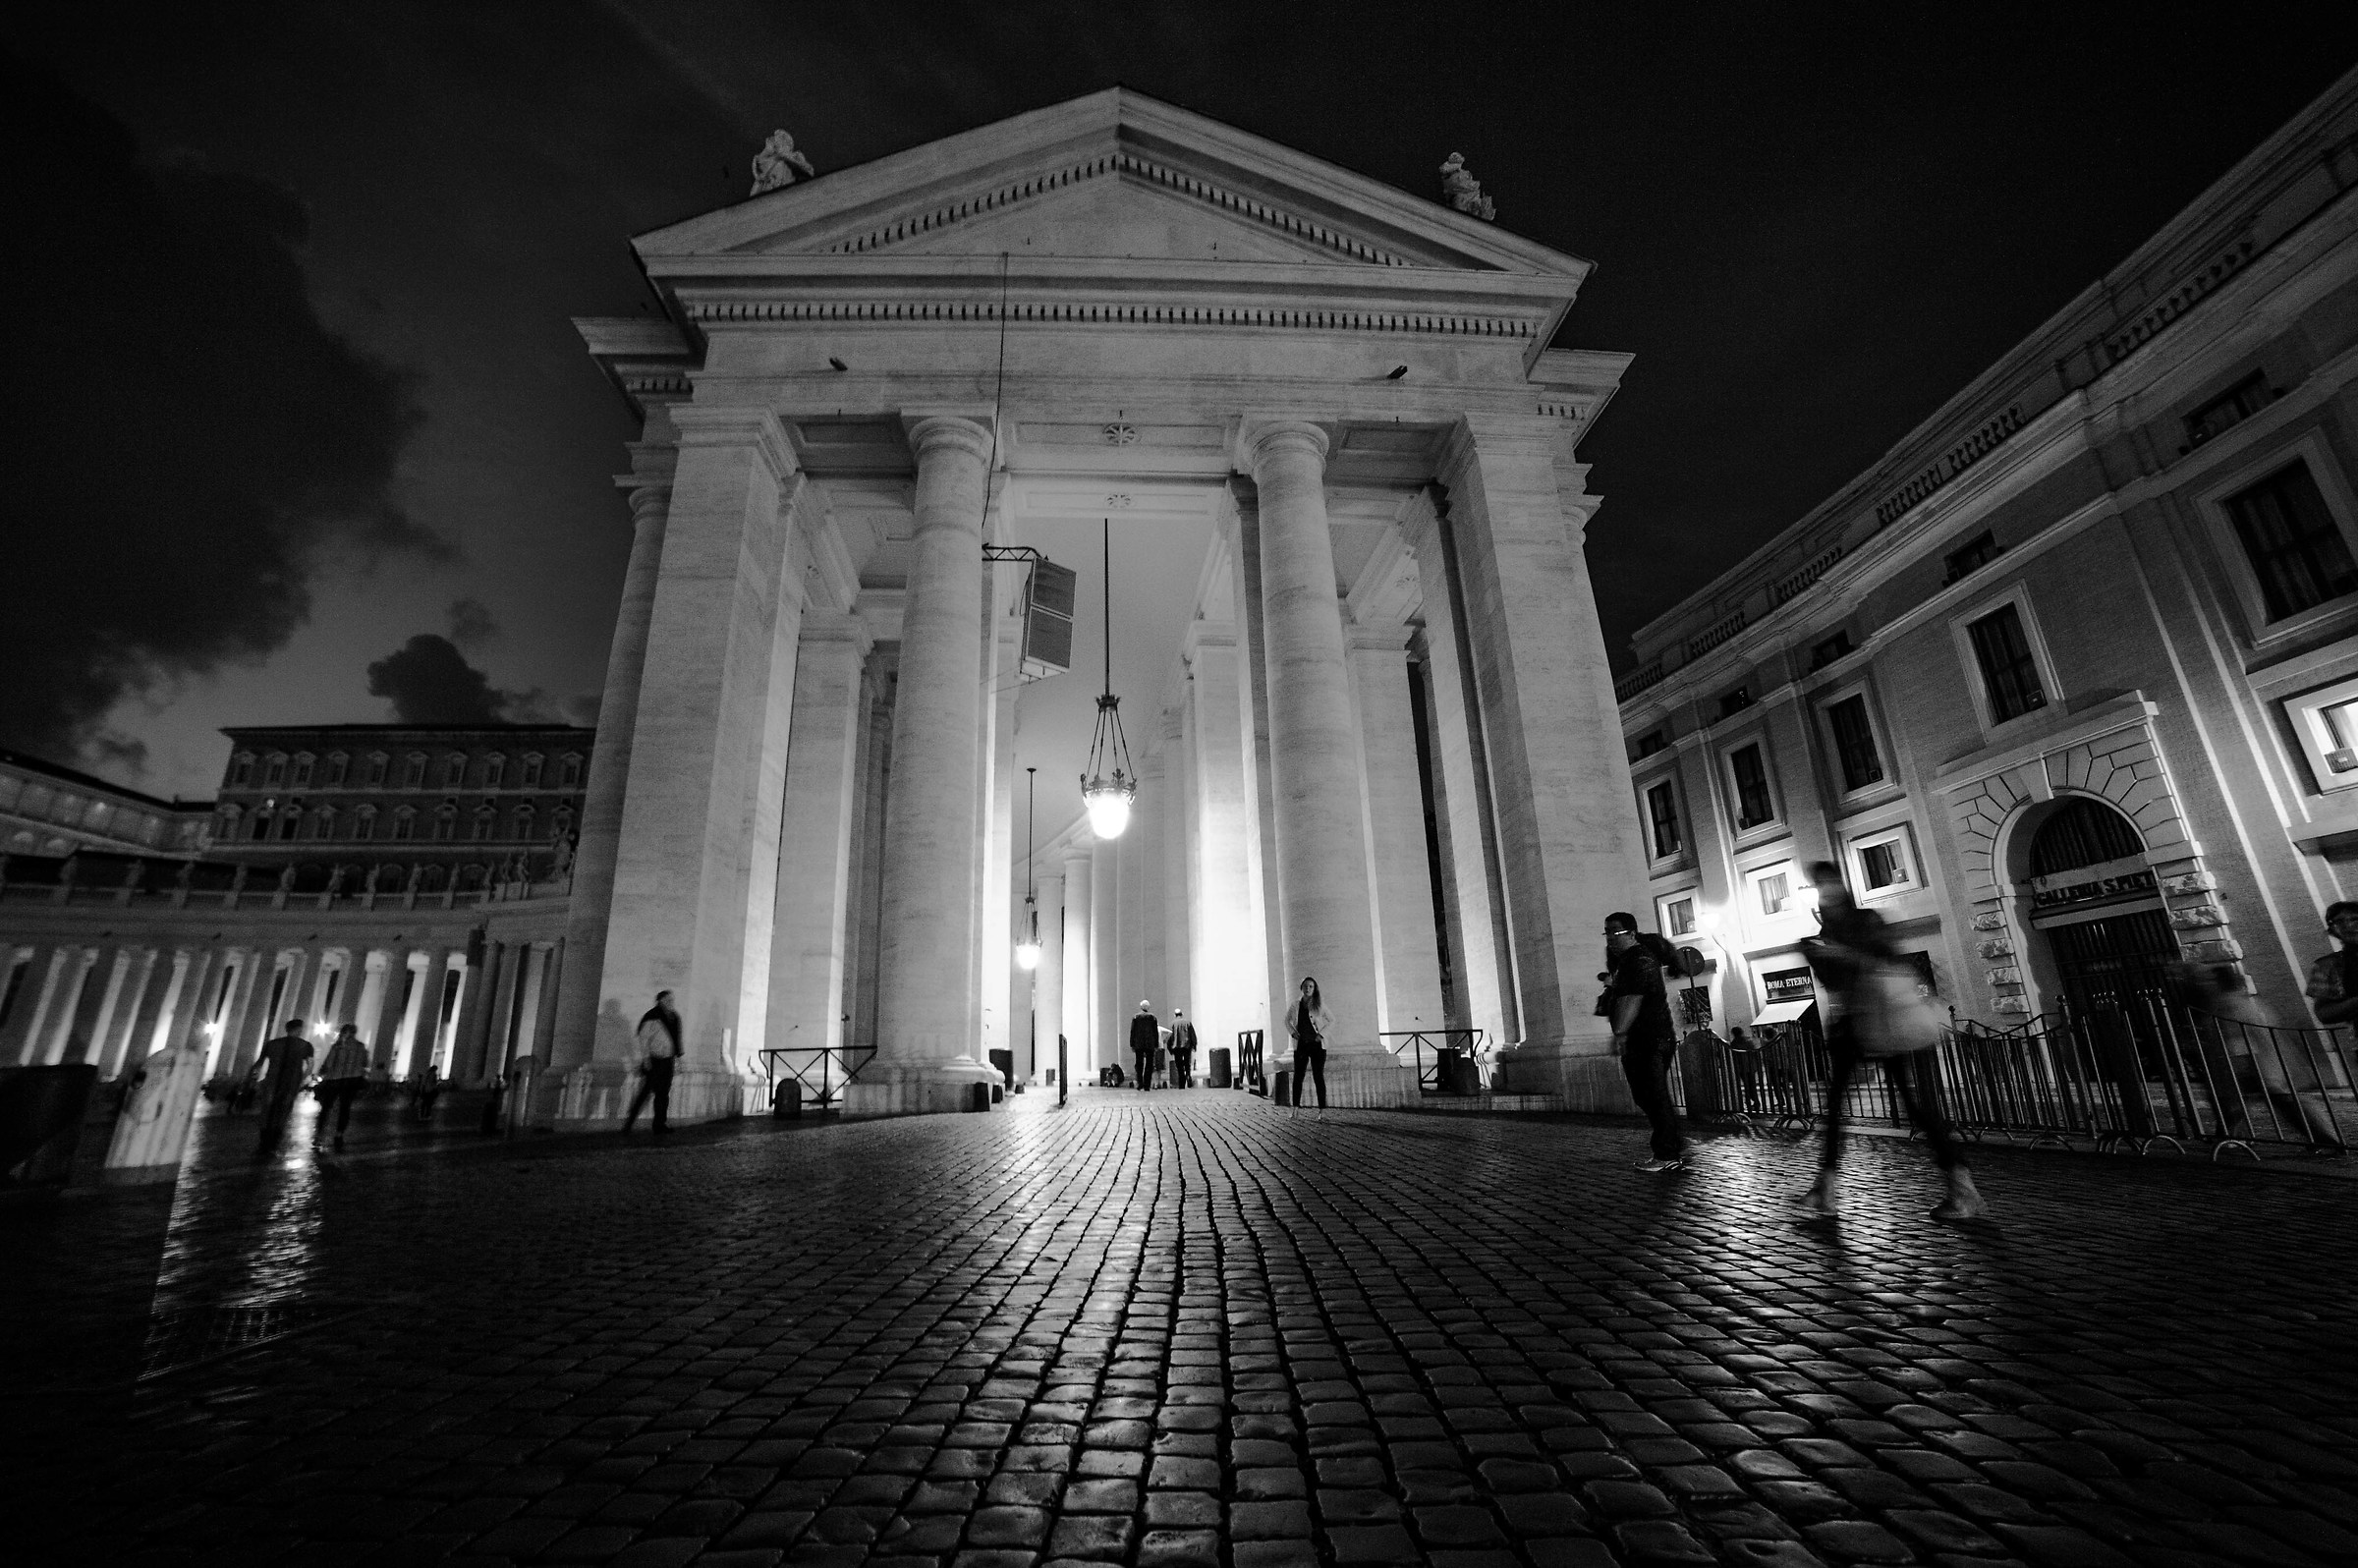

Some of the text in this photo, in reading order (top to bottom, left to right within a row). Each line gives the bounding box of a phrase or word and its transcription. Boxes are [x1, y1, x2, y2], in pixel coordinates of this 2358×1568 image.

[2037, 881, 2104, 905] GALLERIA
[1767, 976, 1813, 990] ROMA ETERNA
